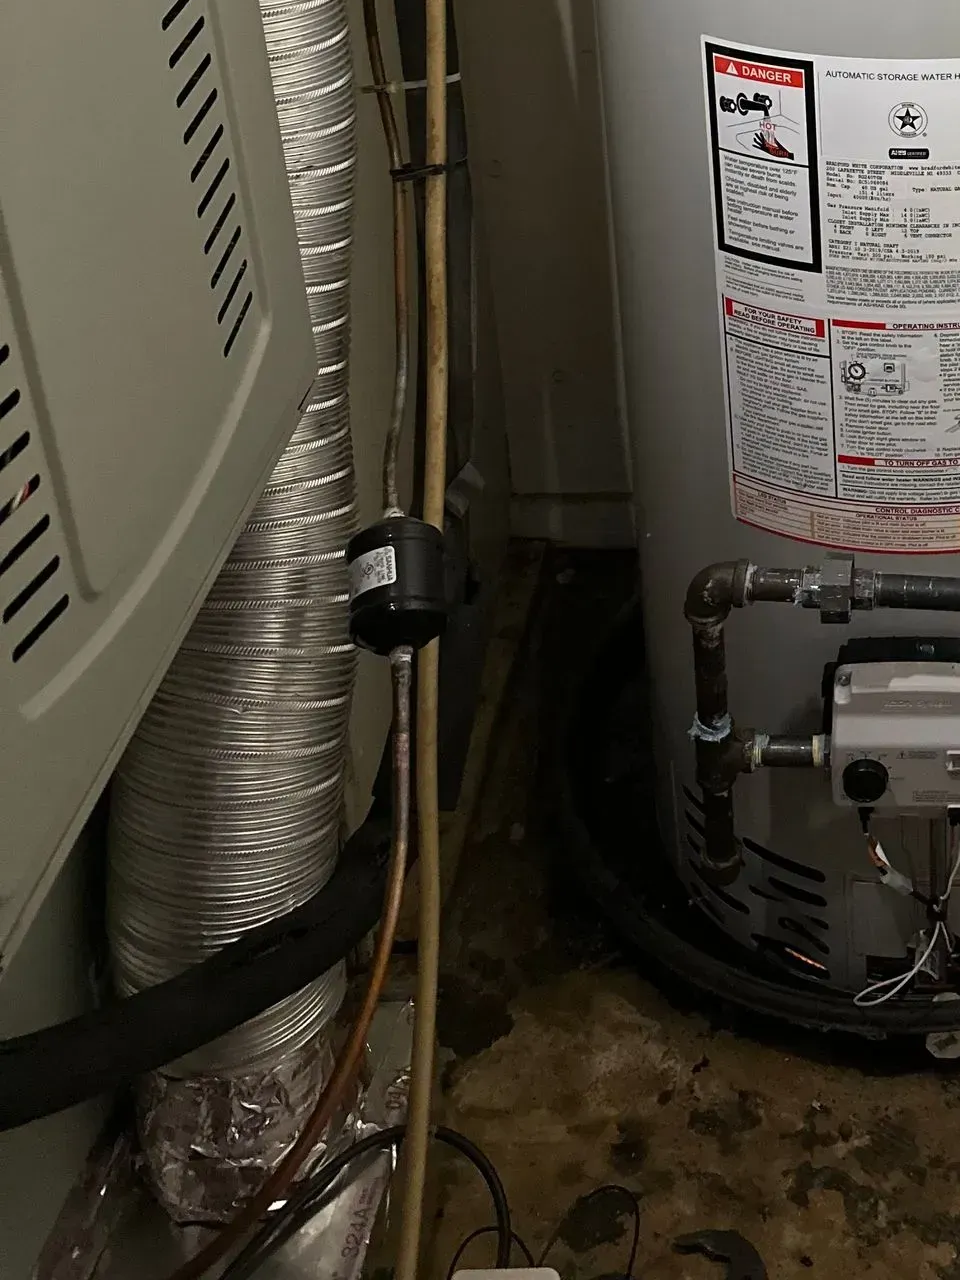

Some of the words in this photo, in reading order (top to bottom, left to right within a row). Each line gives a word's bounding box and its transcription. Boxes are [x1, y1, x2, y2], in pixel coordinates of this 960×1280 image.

[741, 65, 792, 84] DANGER
[826, 70, 874, 80] AUTOMATIC
[876, 72, 918, 80] STORAGE
[920, 72, 952, 80] WATER
[760, 122, 776, 130] HOT
[740, 158, 768, 170] temperature
[750, 166, 766, 174] severe
[724, 168, 744, 176] instantly
[740, 186, 758, 194] highest
[748, 182, 768, 190] disabled
[780, 188, 798, 196] elderly
[738, 198, 760, 210] instruction
[762, 204, 780, 214] manual
[744, 206, 772, 218] temperature
[740, 218, 752, 226] water
[752, 220, 768, 230] before
[770, 224, 788, 234] bathing
[848, 220, 884, 228] INSTALLATION
[728, 228, 758, 240] Temperature
[760, 236, 776, 246] limiting
[744, 306, 758, 314] FOR
[758, 310, 776, 320] YOUR
[776, 314, 802, 324] SAFETY
[734, 310, 750, 318] READ
[750, 314, 776, 326] BEFORE
[778, 320, 816, 334] OPERATING
[768, 494, 786, 504] STATUS
